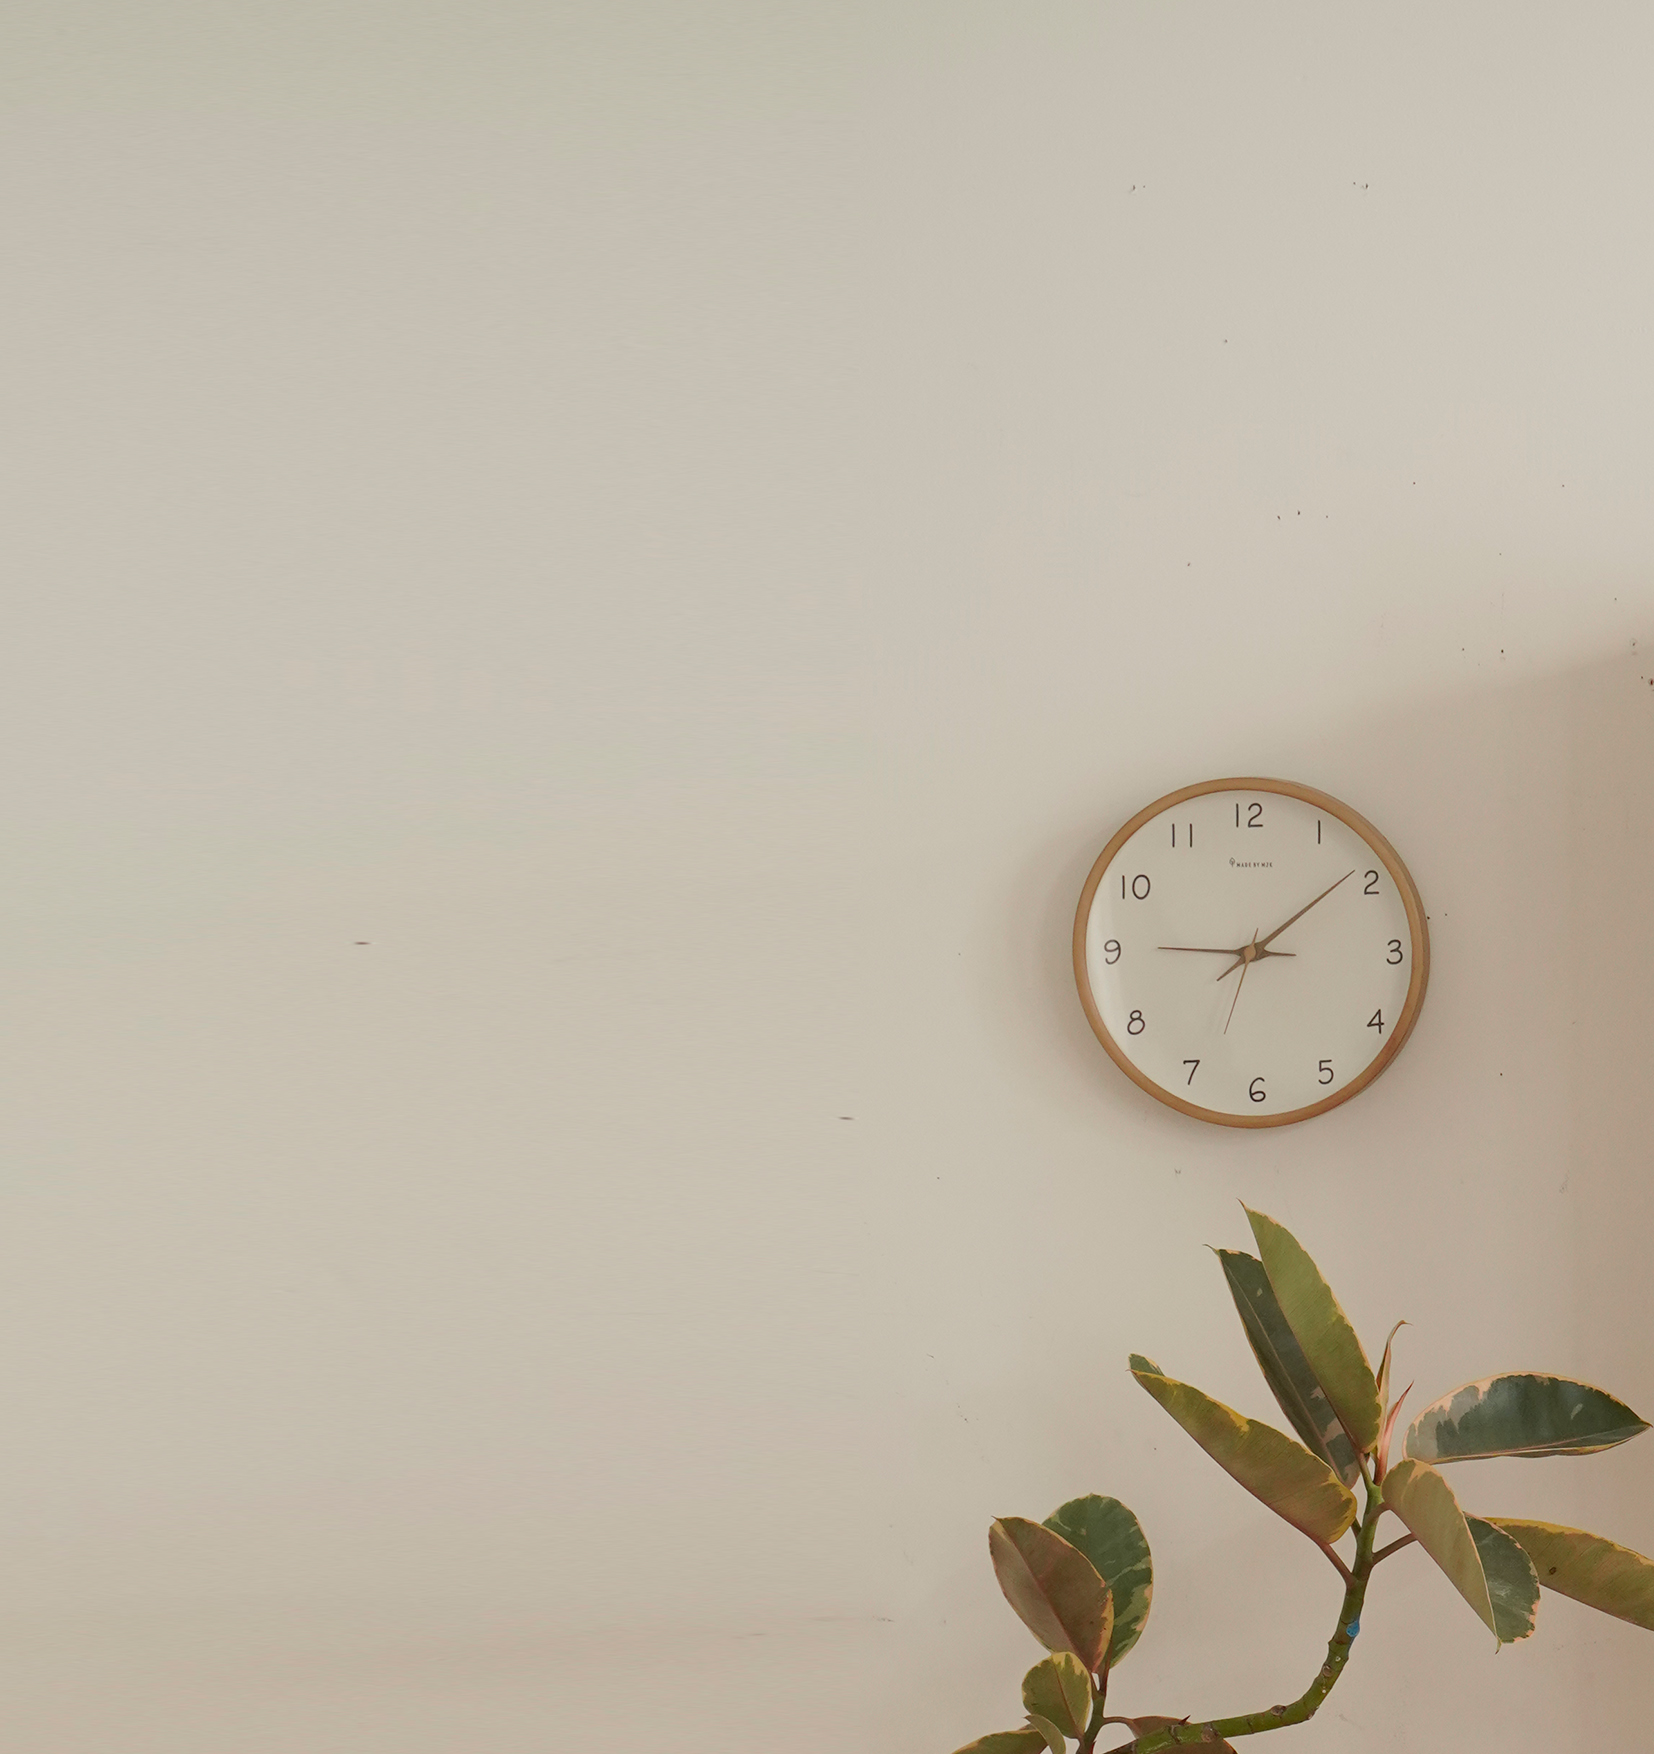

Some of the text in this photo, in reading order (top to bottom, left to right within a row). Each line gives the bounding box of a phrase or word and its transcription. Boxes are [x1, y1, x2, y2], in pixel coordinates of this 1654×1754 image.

[1235, 803, 1264, 828] 12
[1171, 823, 1193, 848] 11
[1316, 819, 1322, 845] 1
[1121, 874, 1151, 900] 10
[1363, 869, 1380, 895] 2
[1103, 939, 1122, 965] 9
[1386, 939, 1404, 965] 3
[1126, 1009, 1146, 1036] 8
[1366, 1008, 1385, 1035] 4
[1182, 1059, 1201, 1086] 7
[1318, 1059, 1334, 1085] 5
[1248, 1076, 1266, 1103] 6
